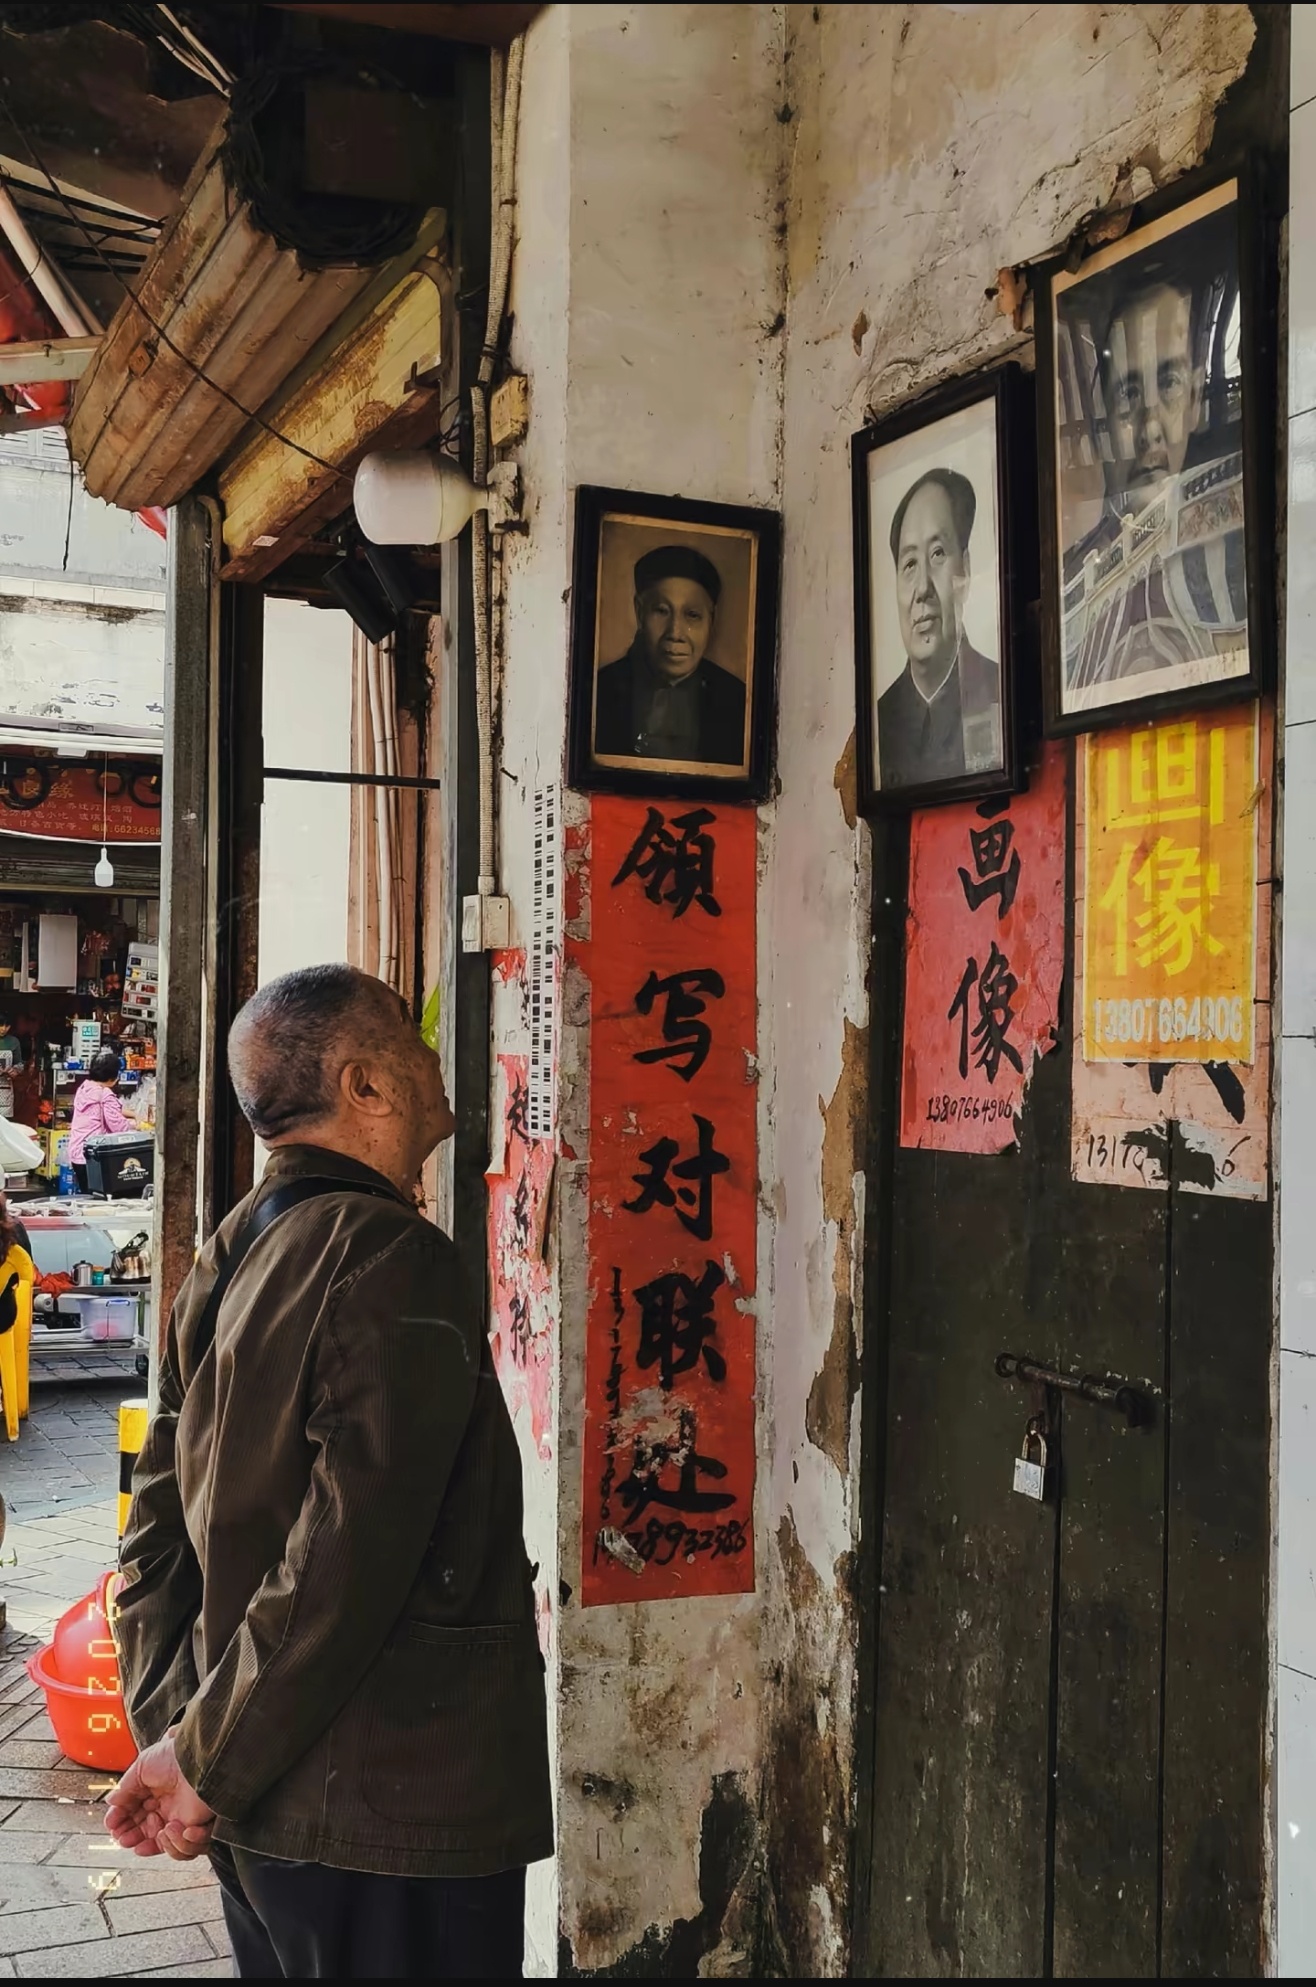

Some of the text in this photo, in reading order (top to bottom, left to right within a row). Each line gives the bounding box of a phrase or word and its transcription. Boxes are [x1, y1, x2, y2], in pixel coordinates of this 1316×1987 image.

[947, 801, 1023, 1084] 画像
[1095, 996, 1243, 1042] 13807664906
[926, 1090, 1014, 1126] 13807664906
